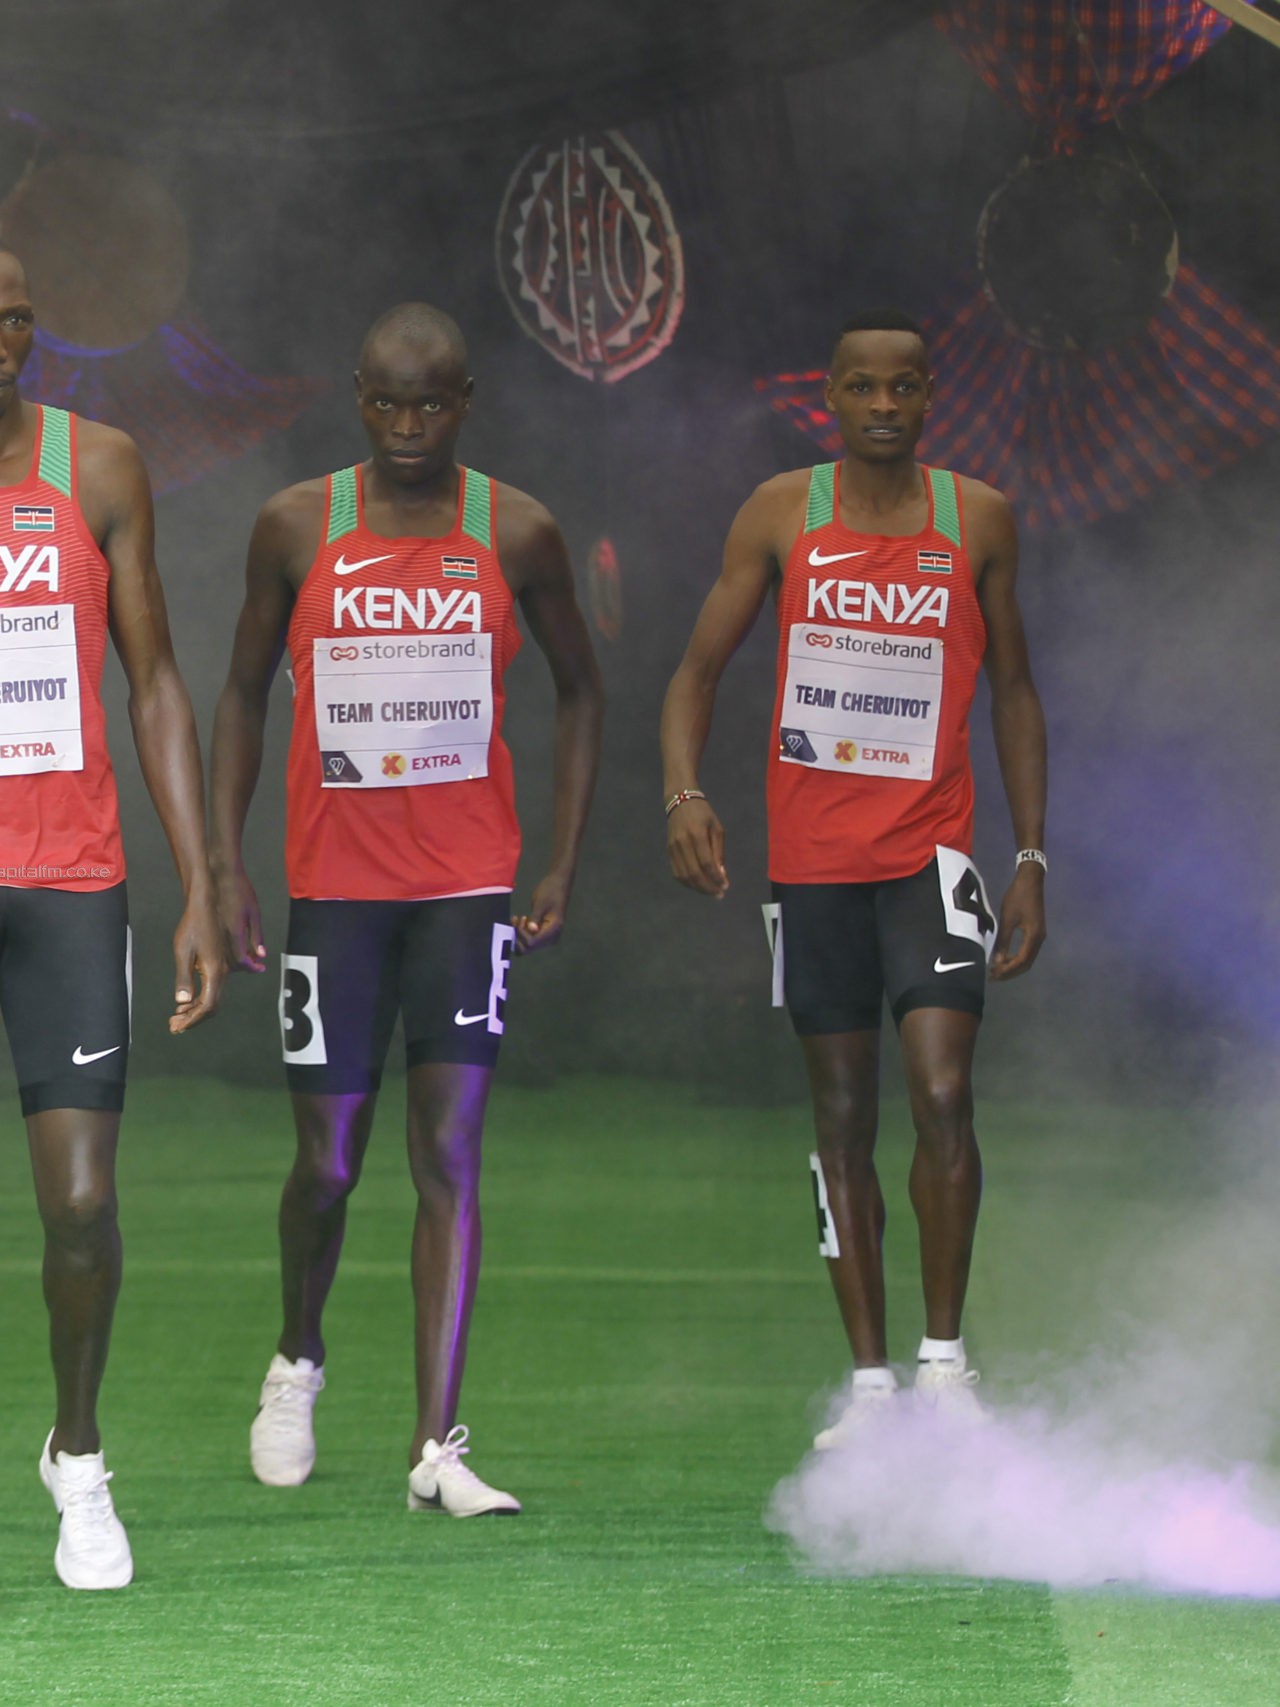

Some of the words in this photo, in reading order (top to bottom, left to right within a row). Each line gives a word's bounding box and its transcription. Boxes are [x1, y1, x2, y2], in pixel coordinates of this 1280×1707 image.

[333, 586, 482, 632] KENYA
[807, 578, 949, 628] KENYA
[363, 639, 476, 660] storebrand
[835, 635, 932, 660] storebrand
[327, 703, 373, 723] TEAM
[381, 699, 481, 722] CHERUIYOT
[796, 684, 836, 709] TEAM
[841, 692, 931, 719] CHERUIYOT
[0, 742, 56, 759] EXTRA
[412, 753, 461, 771] EXTRA
[861, 748, 910, 765] EXTRA
